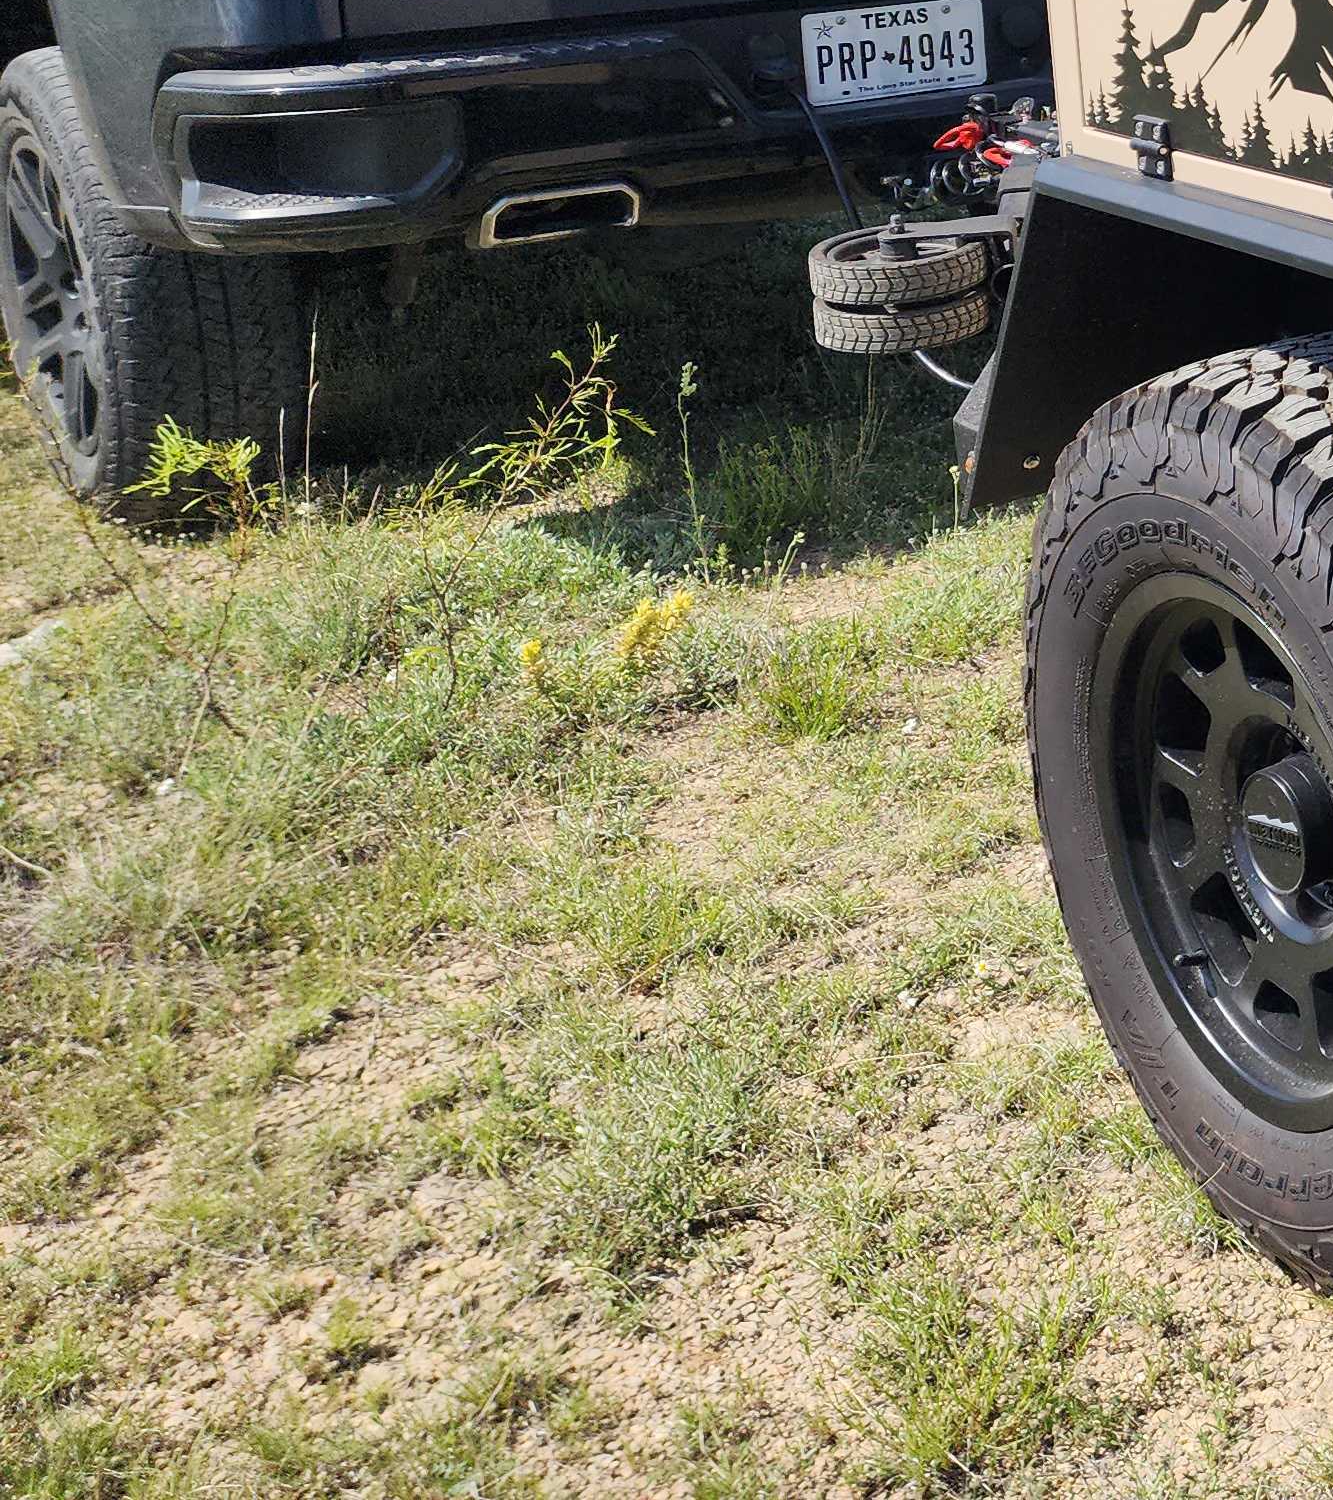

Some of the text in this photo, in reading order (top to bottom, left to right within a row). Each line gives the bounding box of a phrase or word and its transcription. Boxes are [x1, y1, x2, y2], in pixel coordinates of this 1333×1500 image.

[860, 7, 929, 30] TEXAS
[858, 77, 941, 93] The Lone Star State
